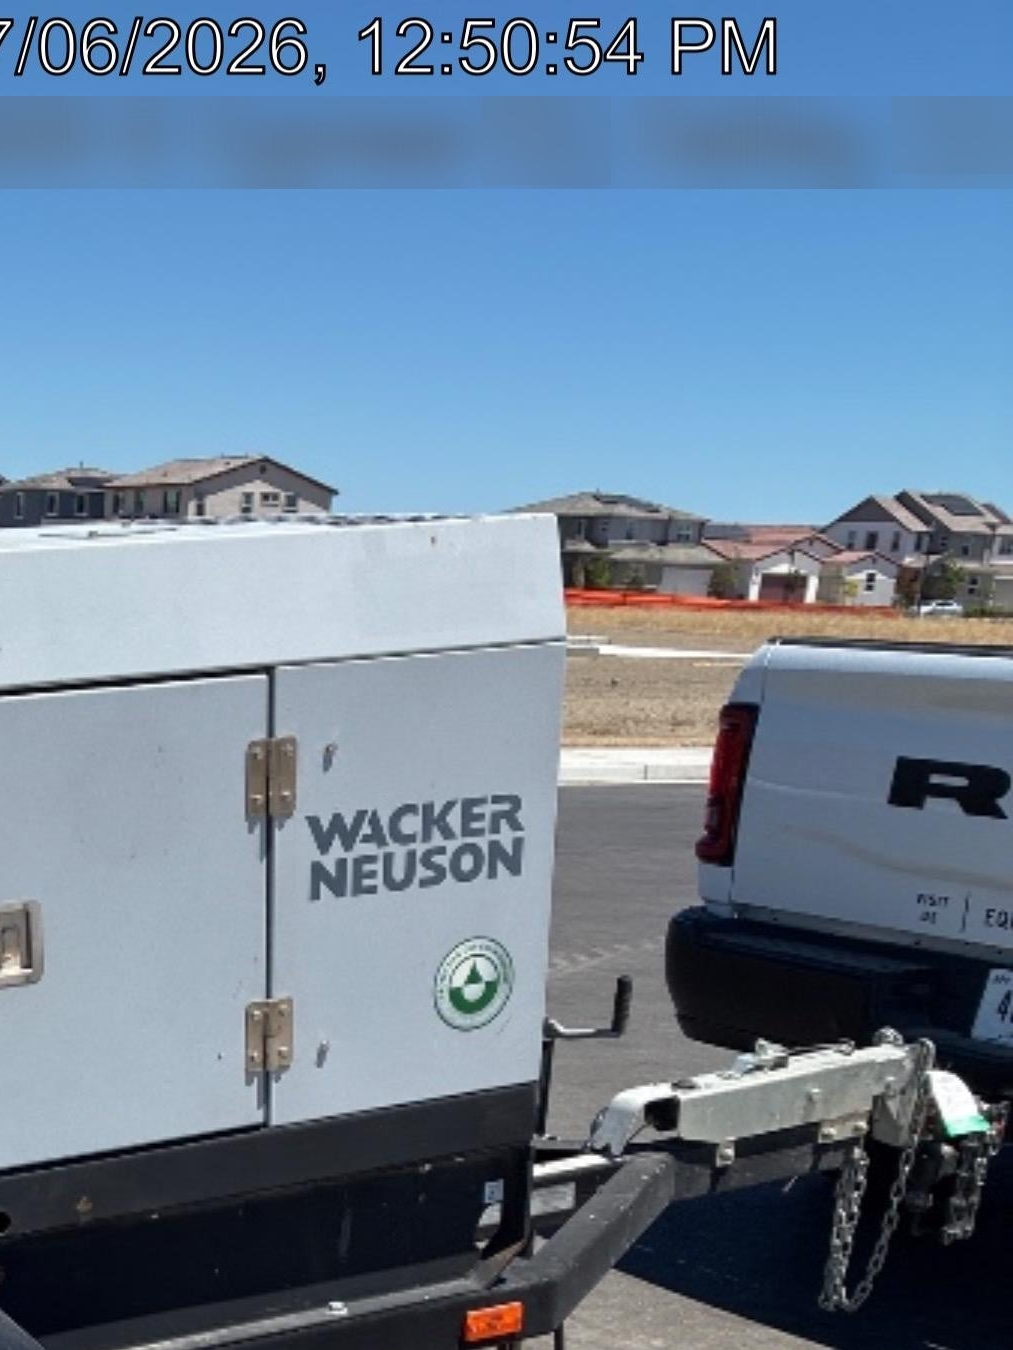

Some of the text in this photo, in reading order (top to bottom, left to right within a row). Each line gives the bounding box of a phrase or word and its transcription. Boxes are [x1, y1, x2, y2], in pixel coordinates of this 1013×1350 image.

[886, 755, 1012, 820] R
[305, 794, 525, 856] WACKER
[308, 836, 525, 902] NEUSON
